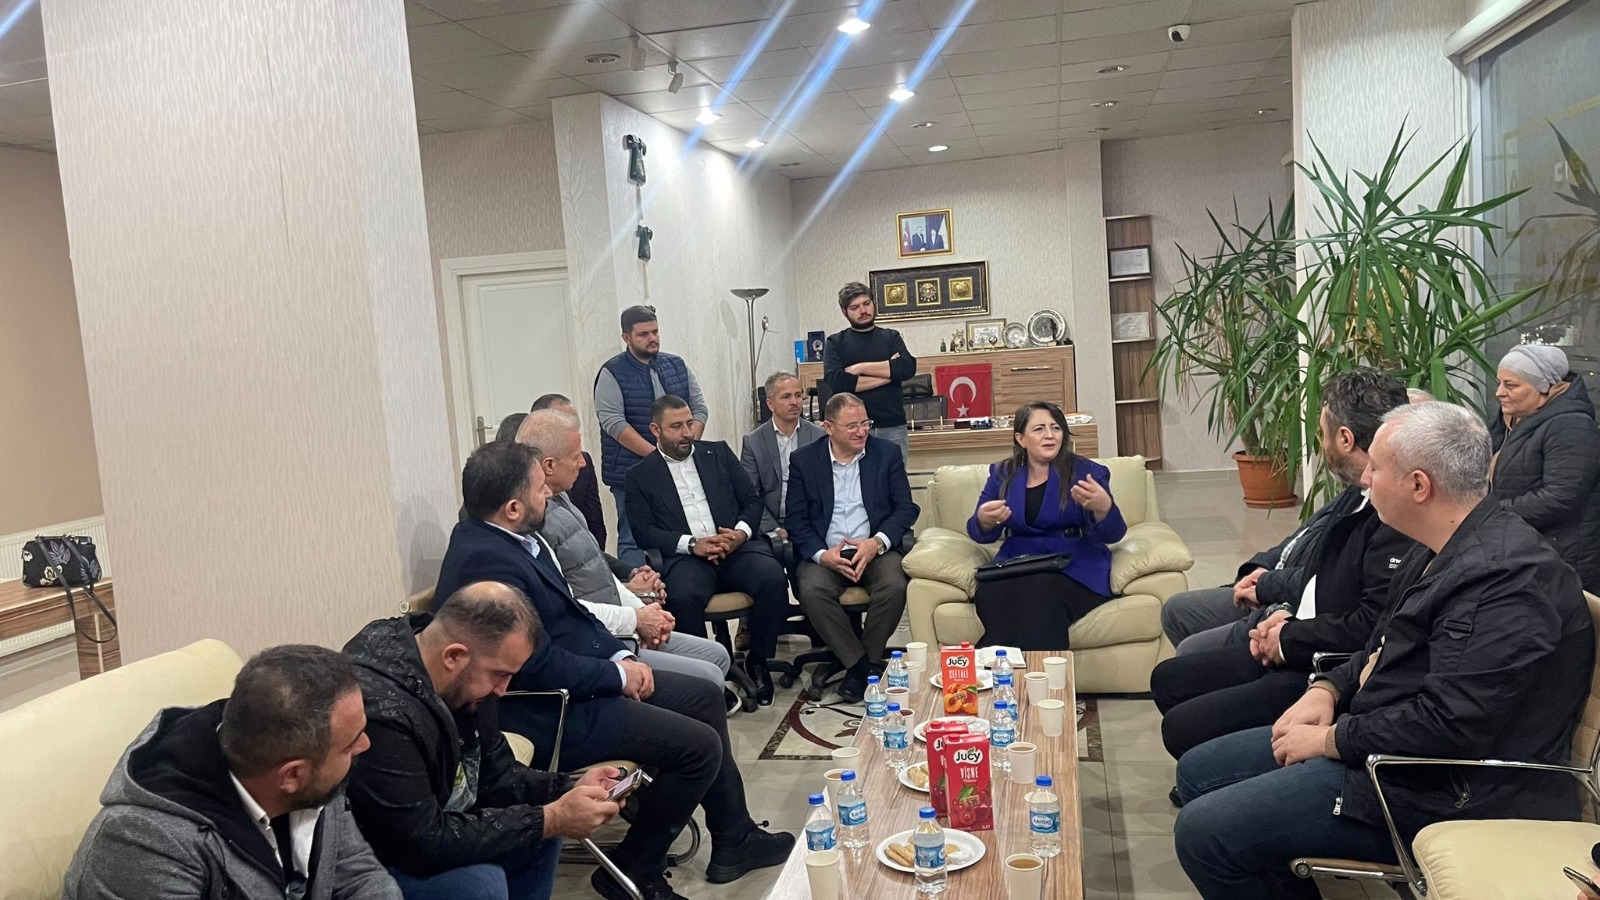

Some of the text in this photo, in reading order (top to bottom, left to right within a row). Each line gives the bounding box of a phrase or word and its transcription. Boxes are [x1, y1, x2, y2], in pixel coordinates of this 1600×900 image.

[948, 658, 967, 667] Jucy
[956, 751, 981, 763] Jucy
[960, 765, 979, 780] VİŞNE
